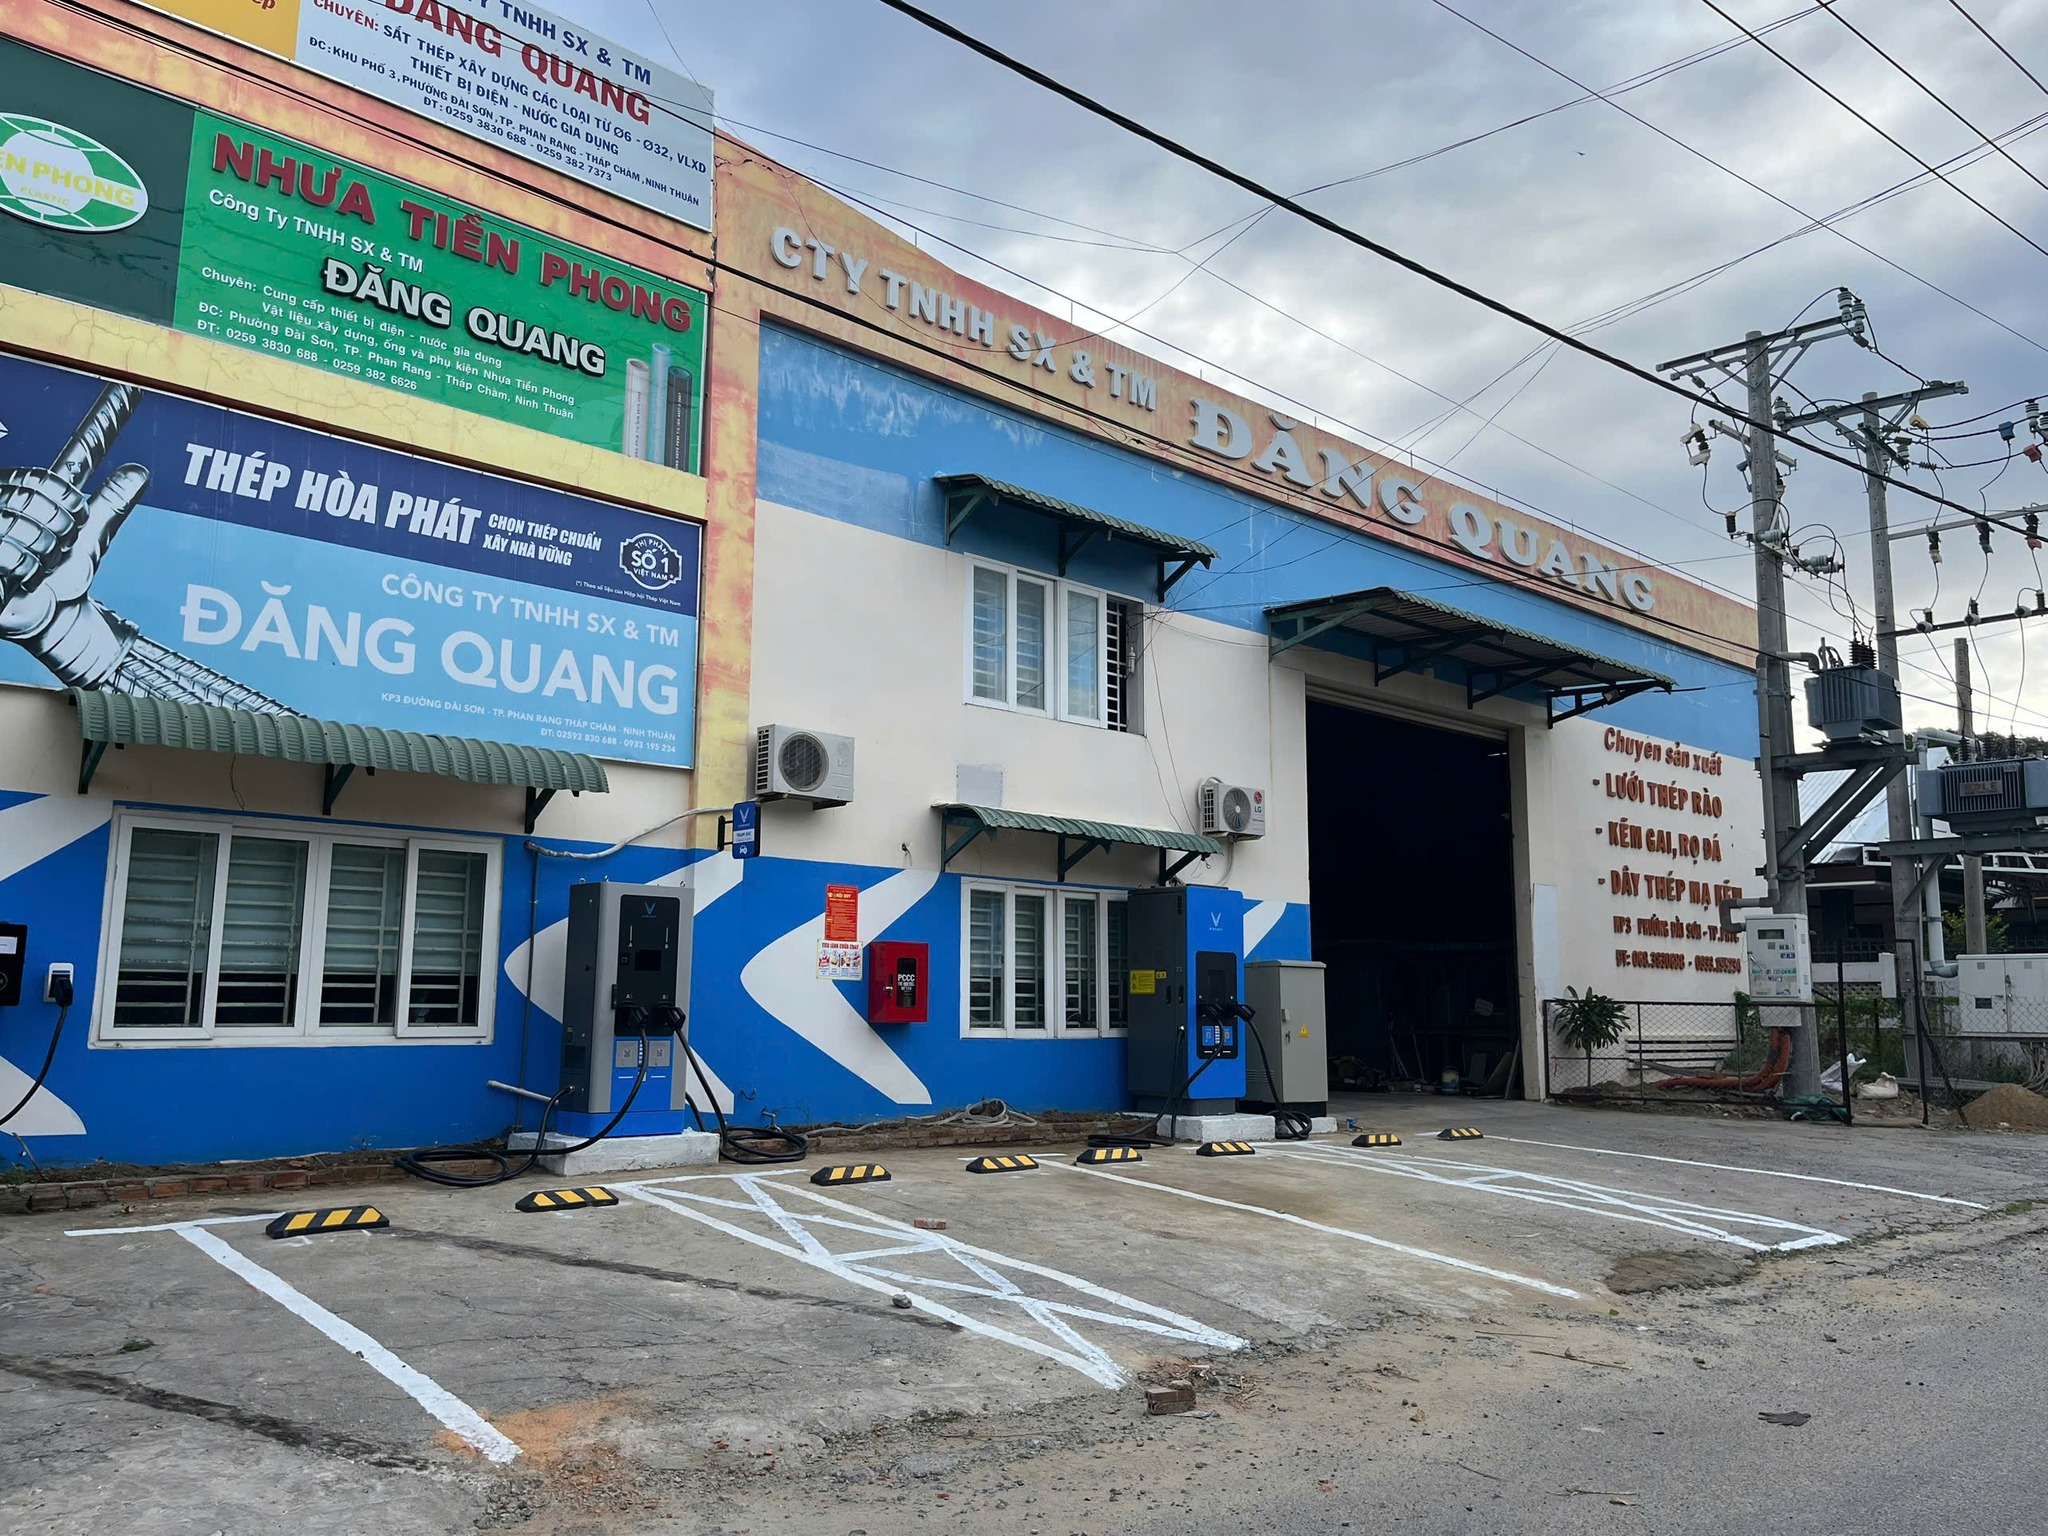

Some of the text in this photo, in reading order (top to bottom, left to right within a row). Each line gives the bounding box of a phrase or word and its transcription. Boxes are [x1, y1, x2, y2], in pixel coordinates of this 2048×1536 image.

[501, 1, 650, 85] TNHH SX & TM
[521, 42, 650, 125] QUANG
[361, 57, 699, 206] PHỐ ĐÀI PHAN RANG THÁP THUẬN
[383, 25, 412, 45] SẮT
[416, 38, 455, 62] THÉP
[458, 59, 487, 78] XÂY
[491, 70, 528, 97] DỰNG
[532, 89, 558, 110] CÁC
[562, 102, 590, 125] LOẠI
[594, 117, 612, 133] TỪ
[677, 152, 707, 174] VLXD
[411, 56, 619, 156] THIẾT BỊ ĐIỆN NƯỚC GIA DỤNG
[32, 160, 136, 207] PHONG
[445, 106, 612, 182] 0259 3830 688 0259 382 7373
[209, 189, 424, 273] Công Ty TNHH SX & TM
[202, 266, 503, 369] Chuyên: Cung cấp thiết bị điện nước gia dụng
[323, 257, 606, 377] ĐĂNG QUANG
[540, 251, 691, 332] PHONG
[770, 226, 1158, 413] CTY TNHH SX & TM
[197, 319, 418, 391] ĐT: 0259 3830 688 0259 382 6626
[198, 302, 223, 317] ĐC:
[229, 310, 279, 336] Phường
[284, 327, 306, 342] Đài
[310, 334, 338, 352] Sơn,
[343, 344, 363, 359] TP.
[368, 352, 397, 369] Phan
[402, 361, 432, 381] Rang
[445, 374, 473, 392] Tháp
[515, 395, 539, 410] Ninh
[262, 302, 284, 317] Vật
[289, 310, 312, 326] liệu
[317, 321, 339, 336] xây
[383, 338, 406, 356] ống
[411, 347, 425, 360] và
[429, 353, 451, 369] phụ
[455, 361, 479, 376] kiện
[483, 369, 511, 386] Nhựa
[542, 387, 575, 406] Phong
[184, 443, 482, 545] THÉP HÒA PHÁT
[488, 513, 525, 537] CHỌN
[527, 522, 558, 541] THÉP
[1190, 397, 1657, 612] ĐĂNG QUANG
[482, 533, 573, 567] XÂY NHÀ VỮNG
[631, 548, 669, 573] SỐ 1
[633, 567, 668, 581] VIỆT NAM
[180, 580, 679, 716] ĐĂNG QUANG
[381, 572, 680, 648] CÔNG TY TNHH SX & TM
[382, 692, 401, 703] KP3
[403, 695, 442, 709] ĐƯỜNG
[445, 700, 462, 712] ĐÀI
[464, 703, 485, 715] SƠN
[507, 710, 534, 722] PHAN
[536, 714, 562, 726] RANG
[565, 718, 588, 728] THÁP
[590, 722, 616, 733] CHÀM
[623, 727, 645, 737] NINH
[647, 730, 676, 742] THUẬN
[540, 727, 555, 738] ĐT:
[556, 729, 583, 741] 02593
[585, 733, 600, 743] 830
[623, 739, 644, 749] 0933
[646, 742, 660, 751] 195
[661, 744, 676, 753] 234
[1665, 742, 1690, 769] sản
[1605, 770, 1723, 819] LƯỚI THÉP RÀO
[1610, 865, 1640, 897] DÂY
[1644, 870, 1686, 901] THÉP
[1689, 880, 1712, 911] MẠ
[1678, 833, 1700, 865] RỌ
